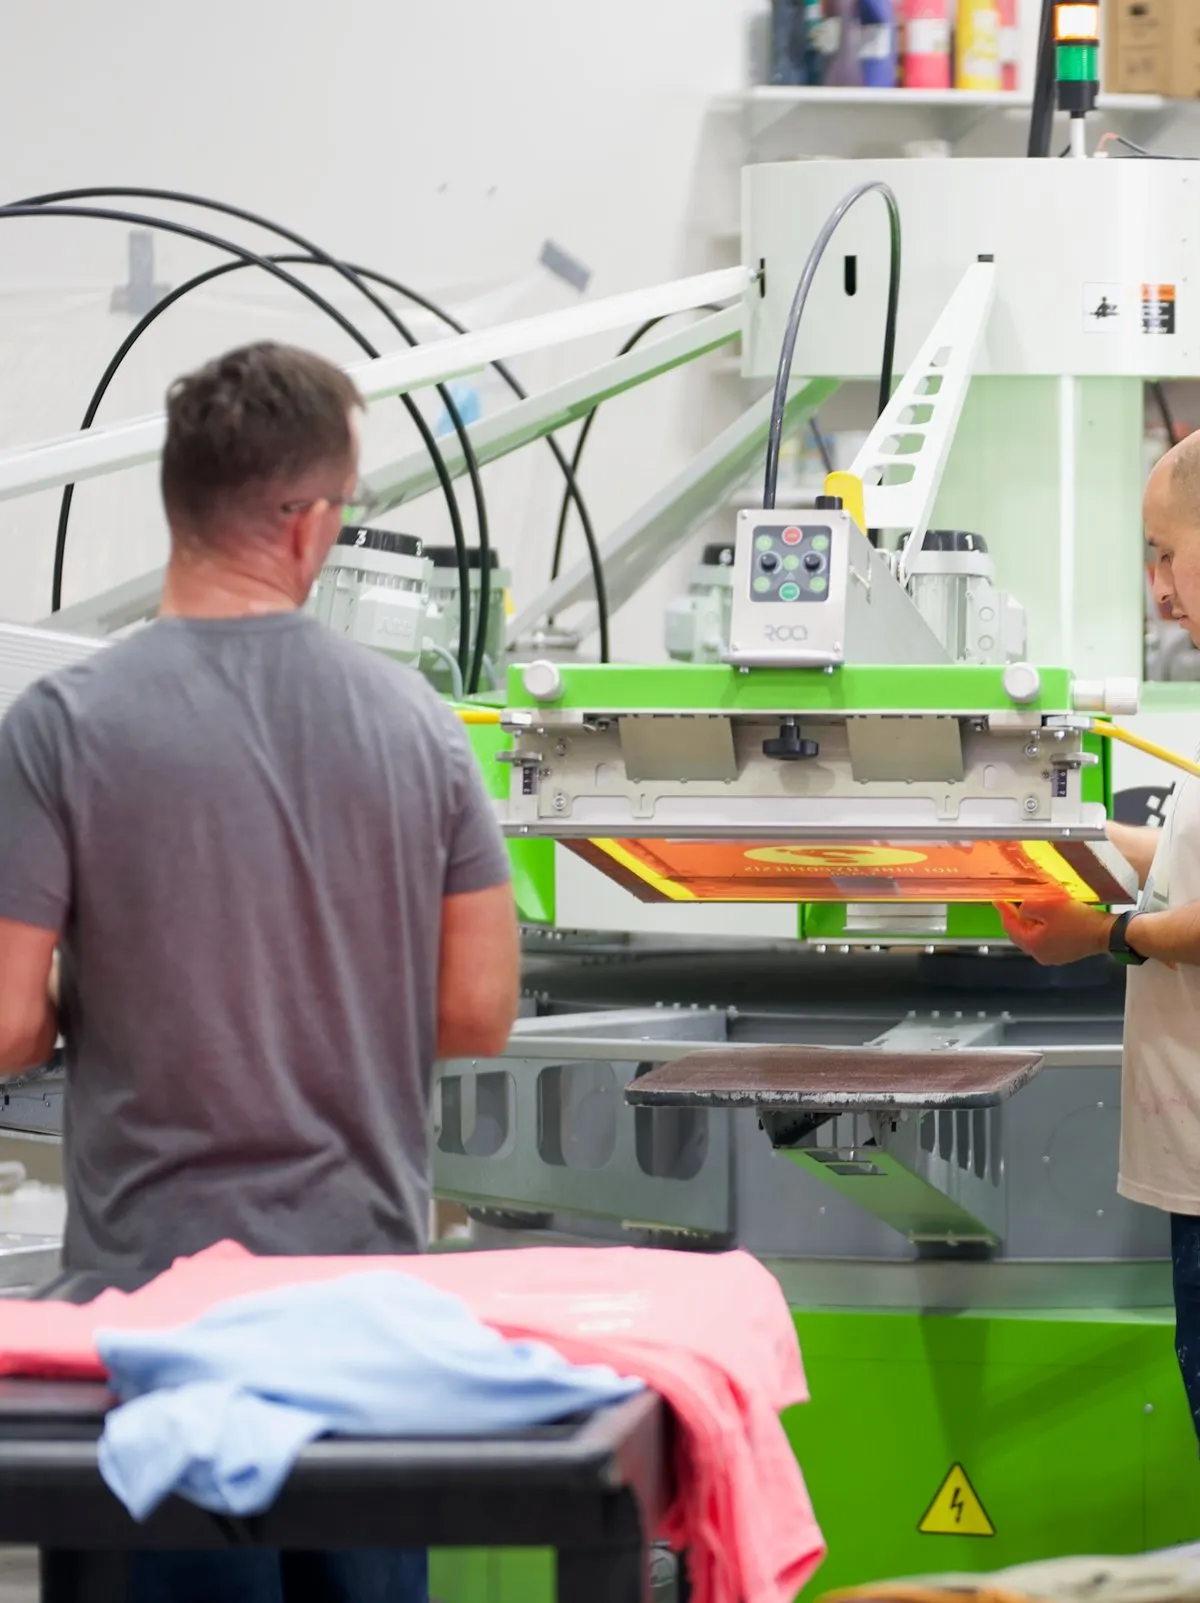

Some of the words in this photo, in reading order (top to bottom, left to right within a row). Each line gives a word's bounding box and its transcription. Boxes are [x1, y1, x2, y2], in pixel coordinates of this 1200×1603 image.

[355, 529, 367, 546] 3
[964, 534, 974, 550] 1
[764, 624, 808, 642] ROQ
